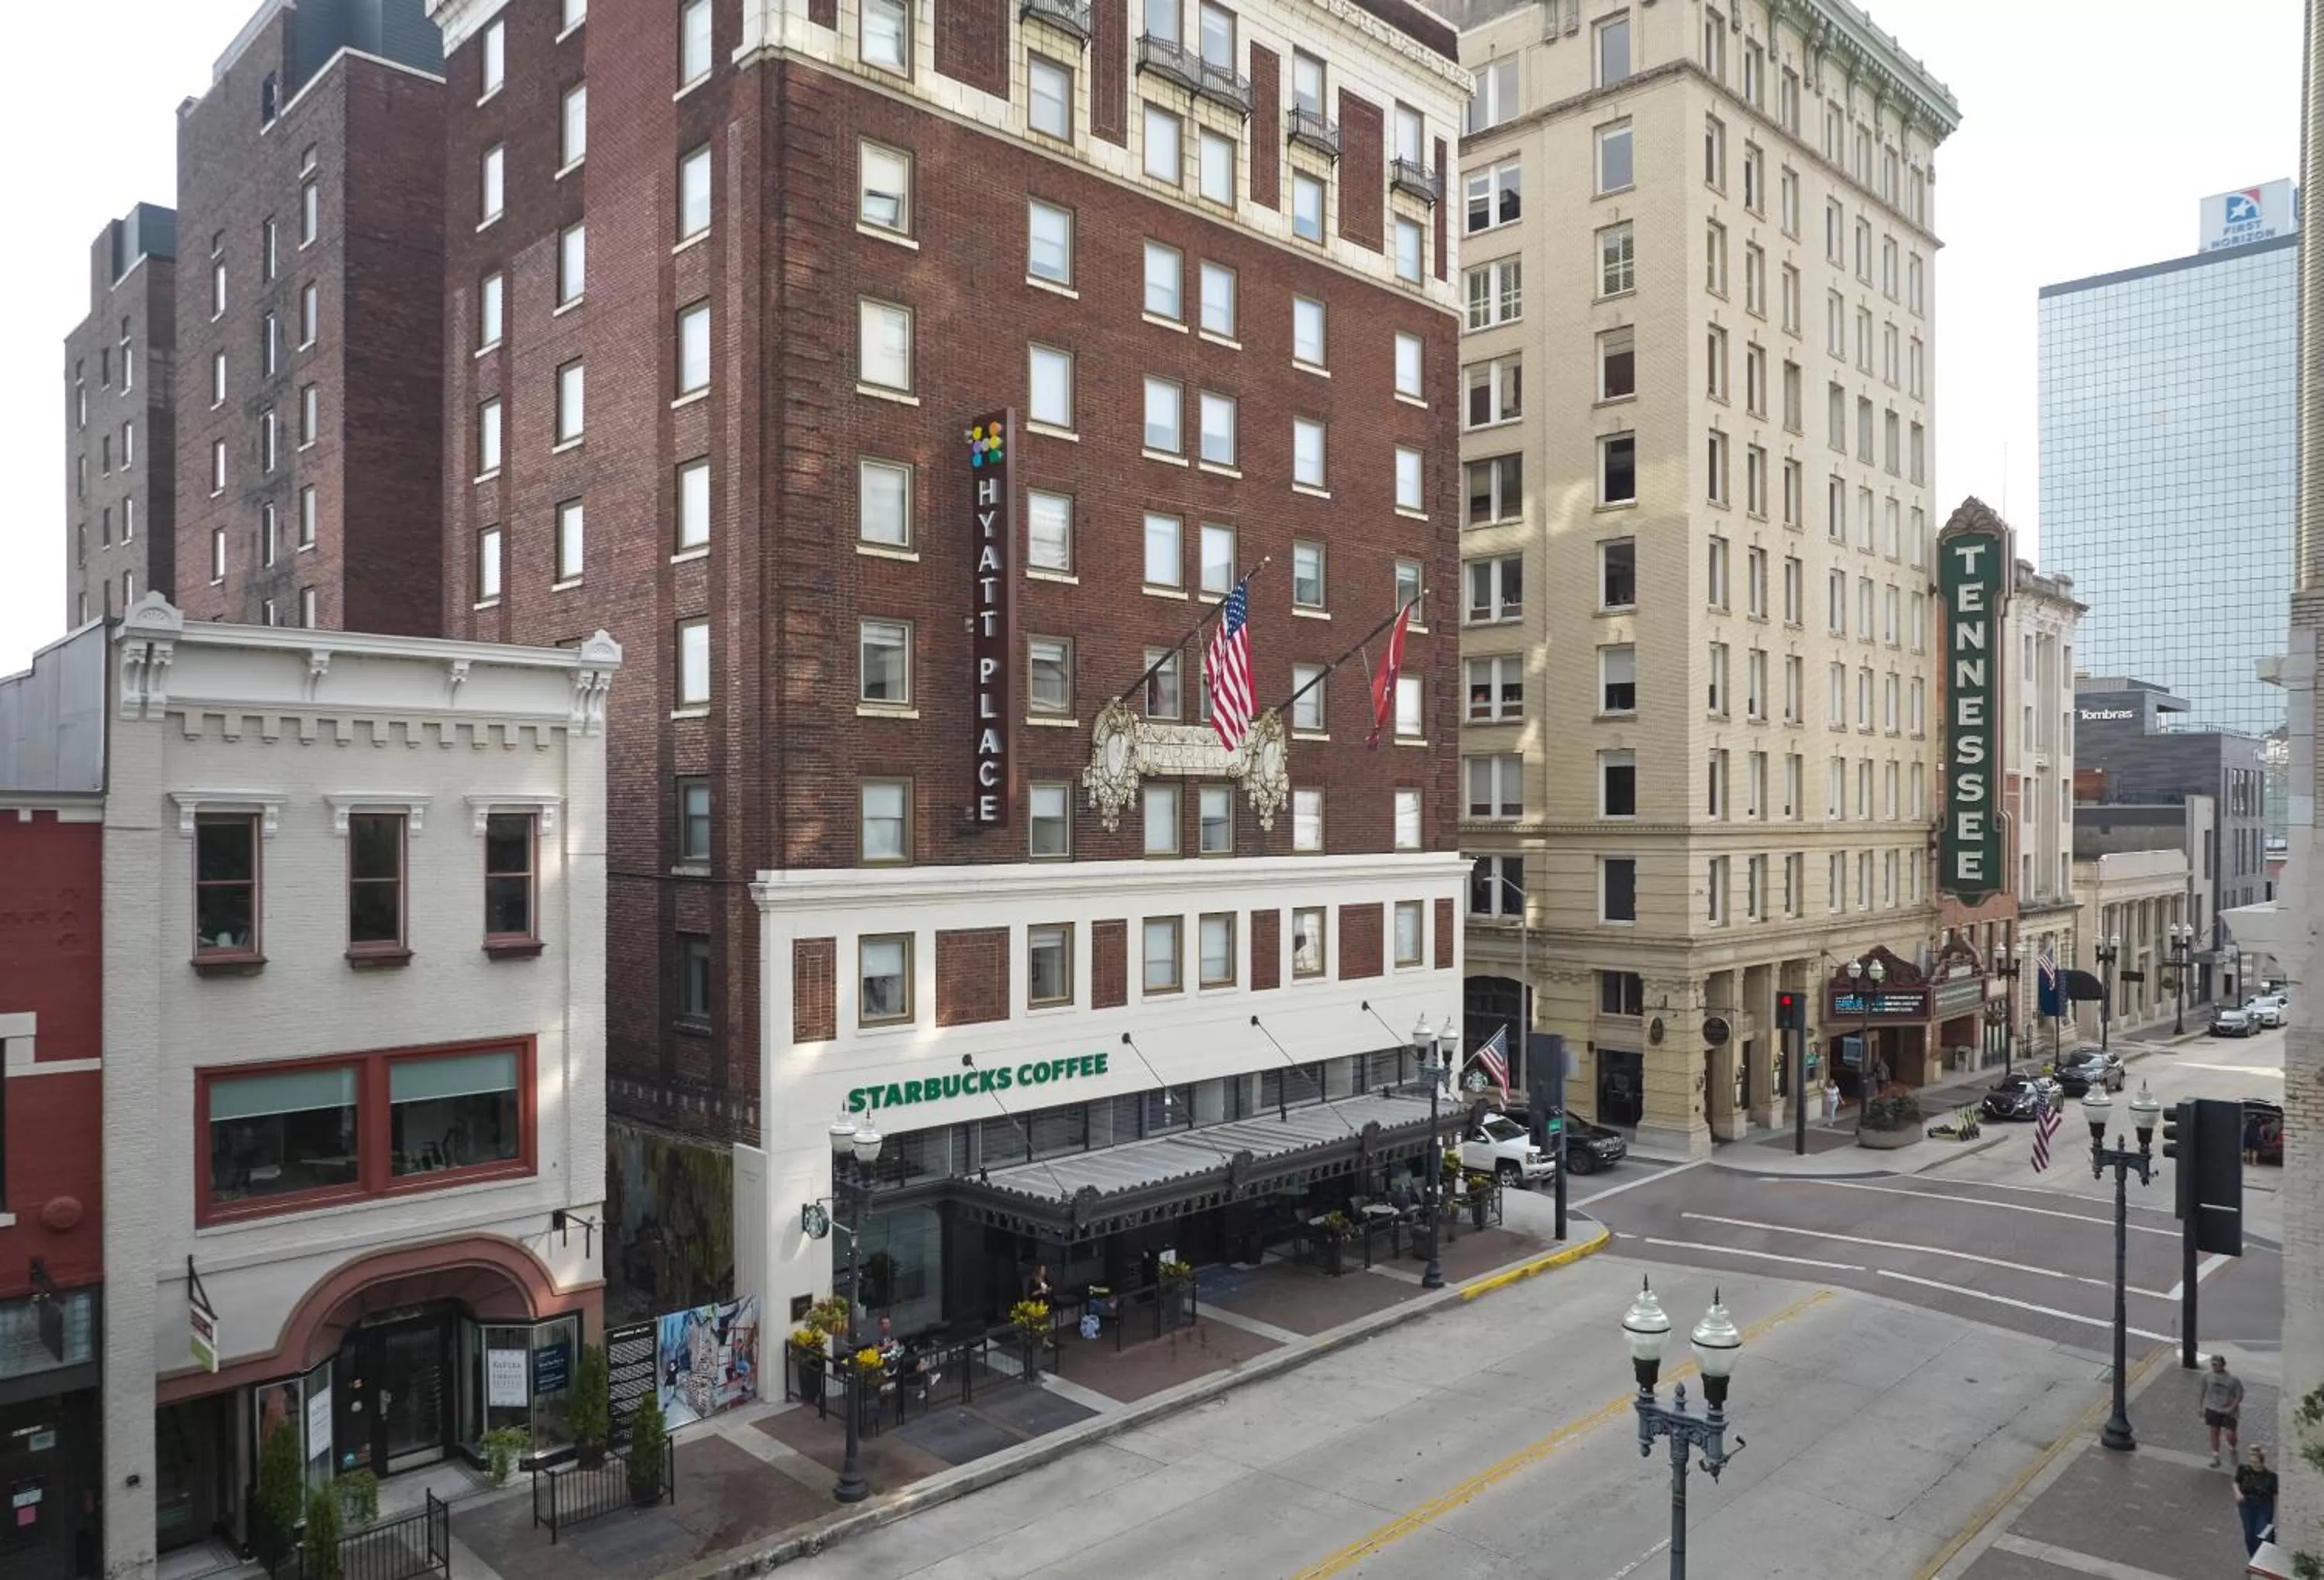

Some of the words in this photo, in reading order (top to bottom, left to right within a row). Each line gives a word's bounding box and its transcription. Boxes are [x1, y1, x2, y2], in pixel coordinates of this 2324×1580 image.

[2211, 228, 2276, 248] HORIZON
[2223, 219, 2262, 236] FIRST
[978, 478, 1001, 637] HYATT
[978, 658, 1002, 821] PLACE
[1954, 544, 1985, 881] TENNESSEE
[2081, 709, 2133, 720] Tombras
[847, 1066, 1012, 1113] STARBUCKS
[1017, 1053, 1109, 1087] COFFEE
